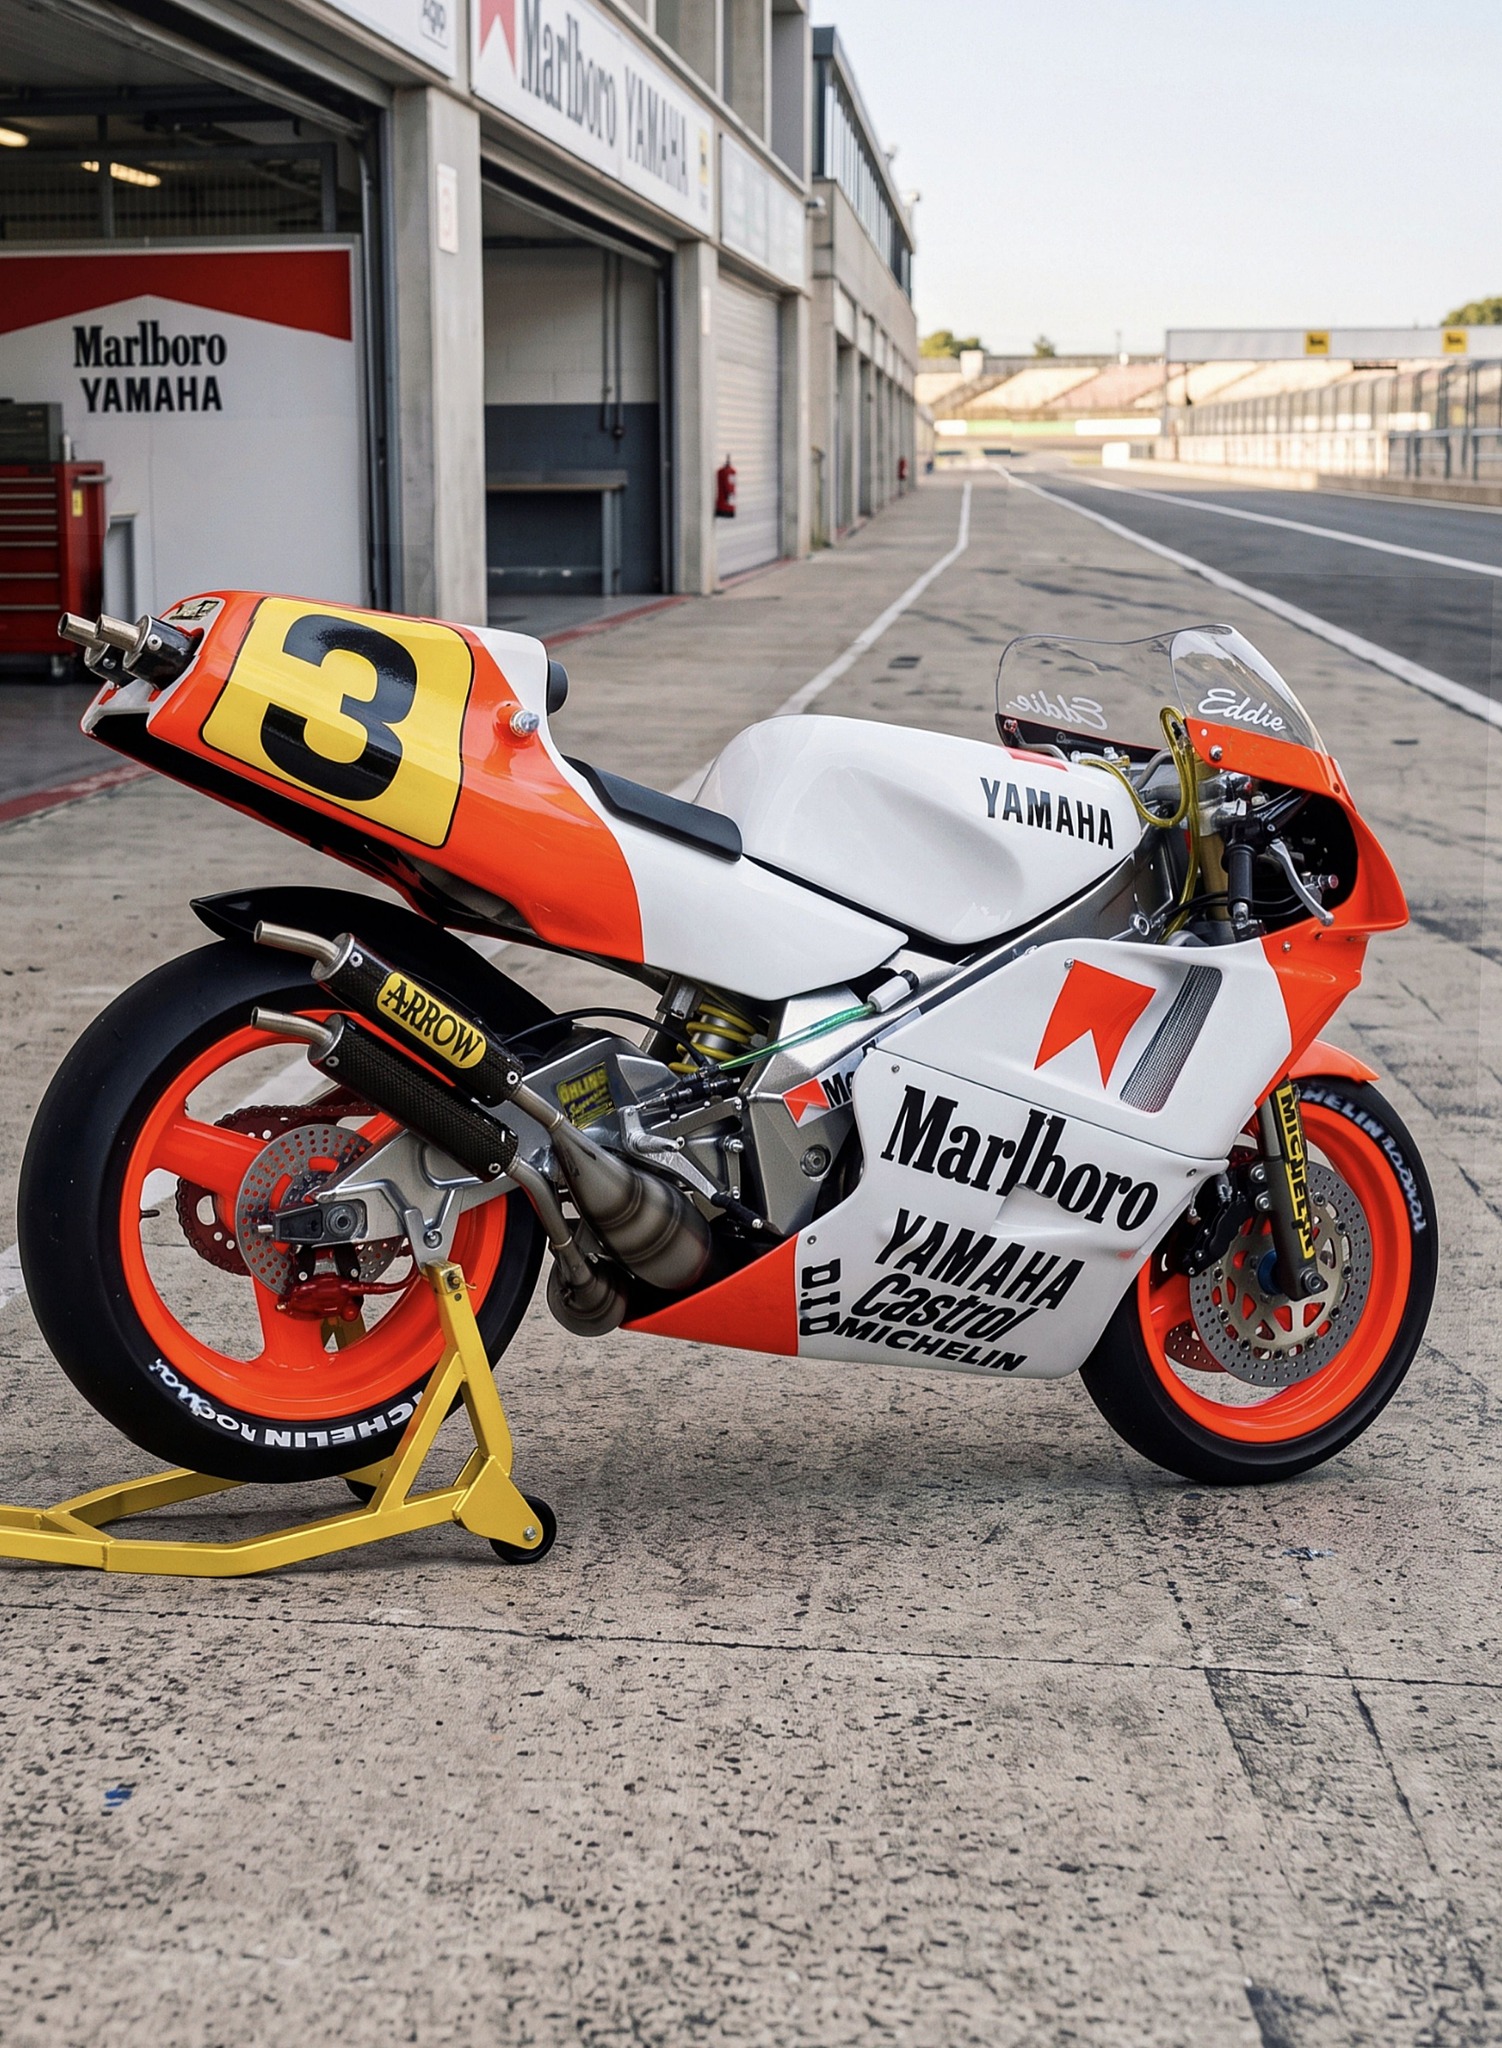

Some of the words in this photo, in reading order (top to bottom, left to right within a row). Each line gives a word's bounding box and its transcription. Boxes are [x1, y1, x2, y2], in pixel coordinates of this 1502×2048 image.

[521, 0, 616, 148] Marlboro
[625, 64, 689, 197] YAMAHA
[73, 320, 228, 368] Marlboro
[80, 376, 222, 413] YAMAHA
[260, 614, 418, 801] 3
[1197, 687, 1287, 732] Eddie
[980, 776, 1114, 850] YAMAHA
[381, 979, 484, 1063] ARROW
[880, 1084, 1159, 1232] Marlboro
[874, 1208, 1085, 1310] YAMAHA
[834, 1316, 1028, 1372] MICHELIN
[851, 1273, 1038, 1343] Castrol
